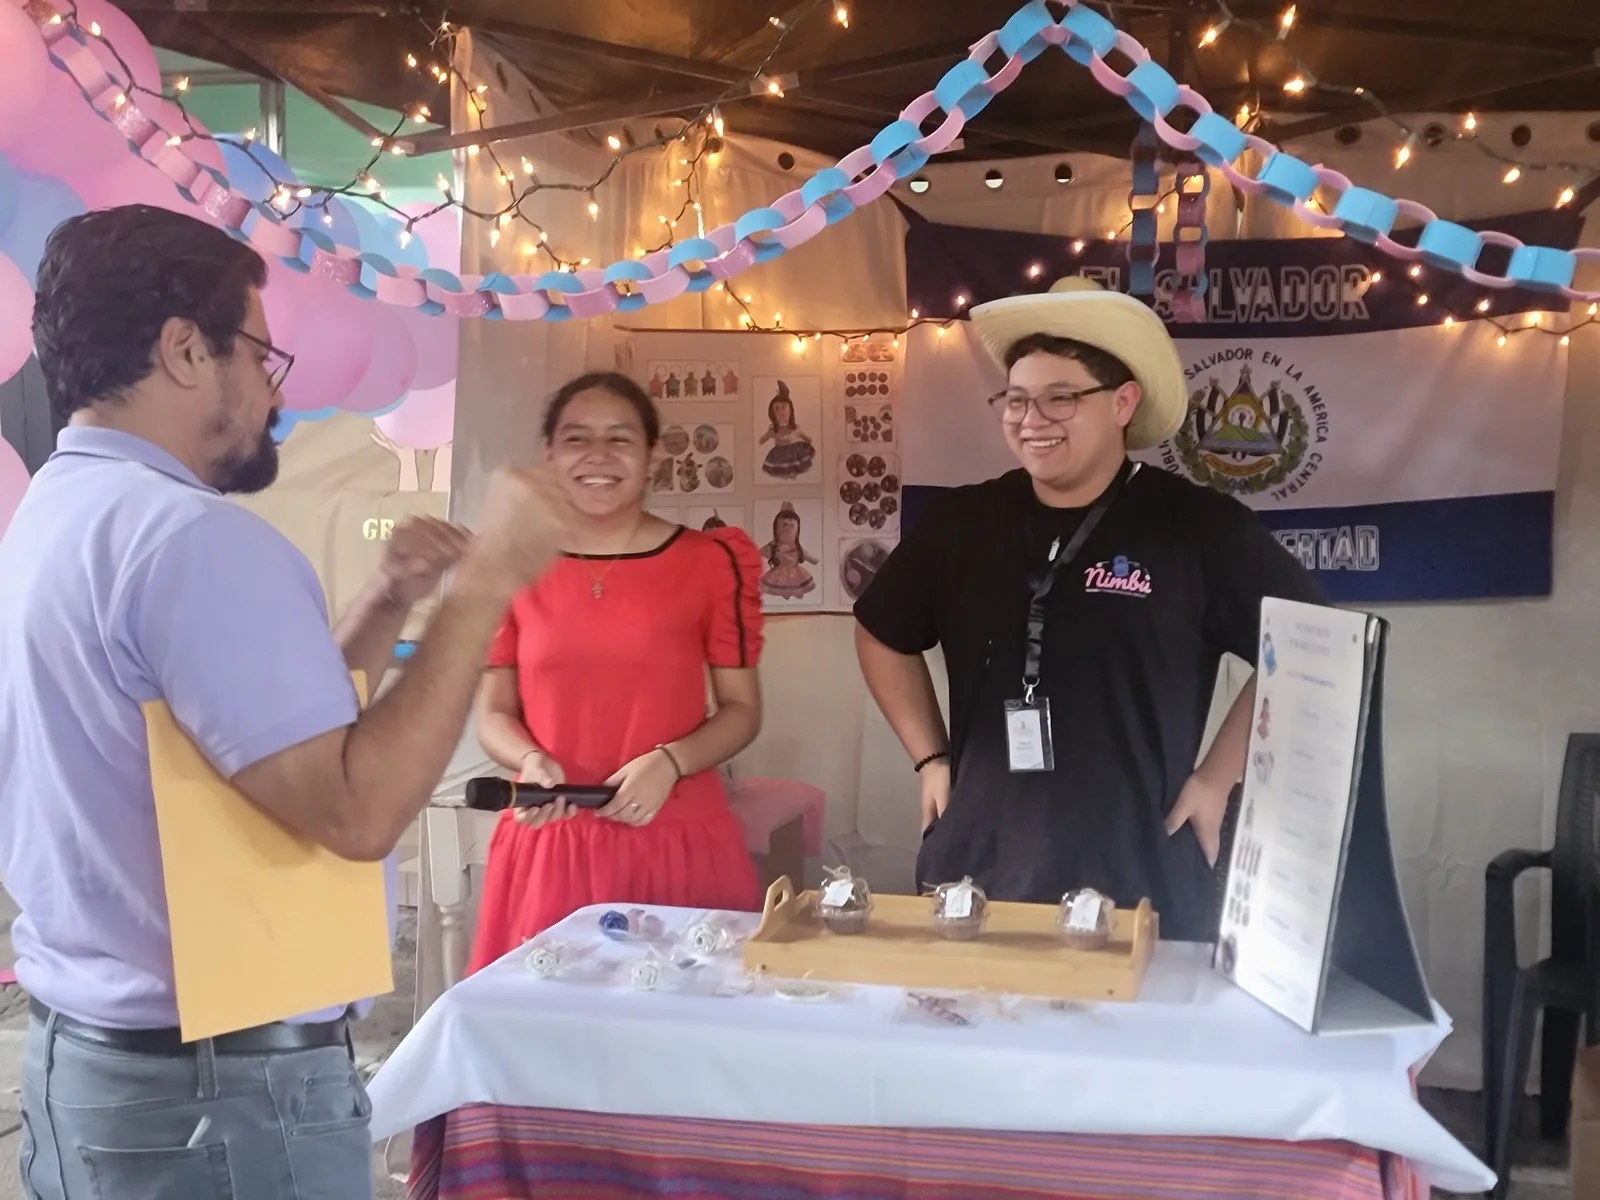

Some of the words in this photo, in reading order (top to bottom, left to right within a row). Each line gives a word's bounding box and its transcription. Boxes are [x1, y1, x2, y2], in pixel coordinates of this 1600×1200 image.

[1154, 264, 1371, 323] SLVADOR
[1184, 348, 1253, 380] SALVADOR
[1261, 351, 1282, 367] EN
[1285, 363, 1303, 382] LA
[1303, 384, 1330, 443] AMERICA
[1269, 452, 1323, 501] CENTRAL
[1271, 525, 1380, 571] ERTAD
